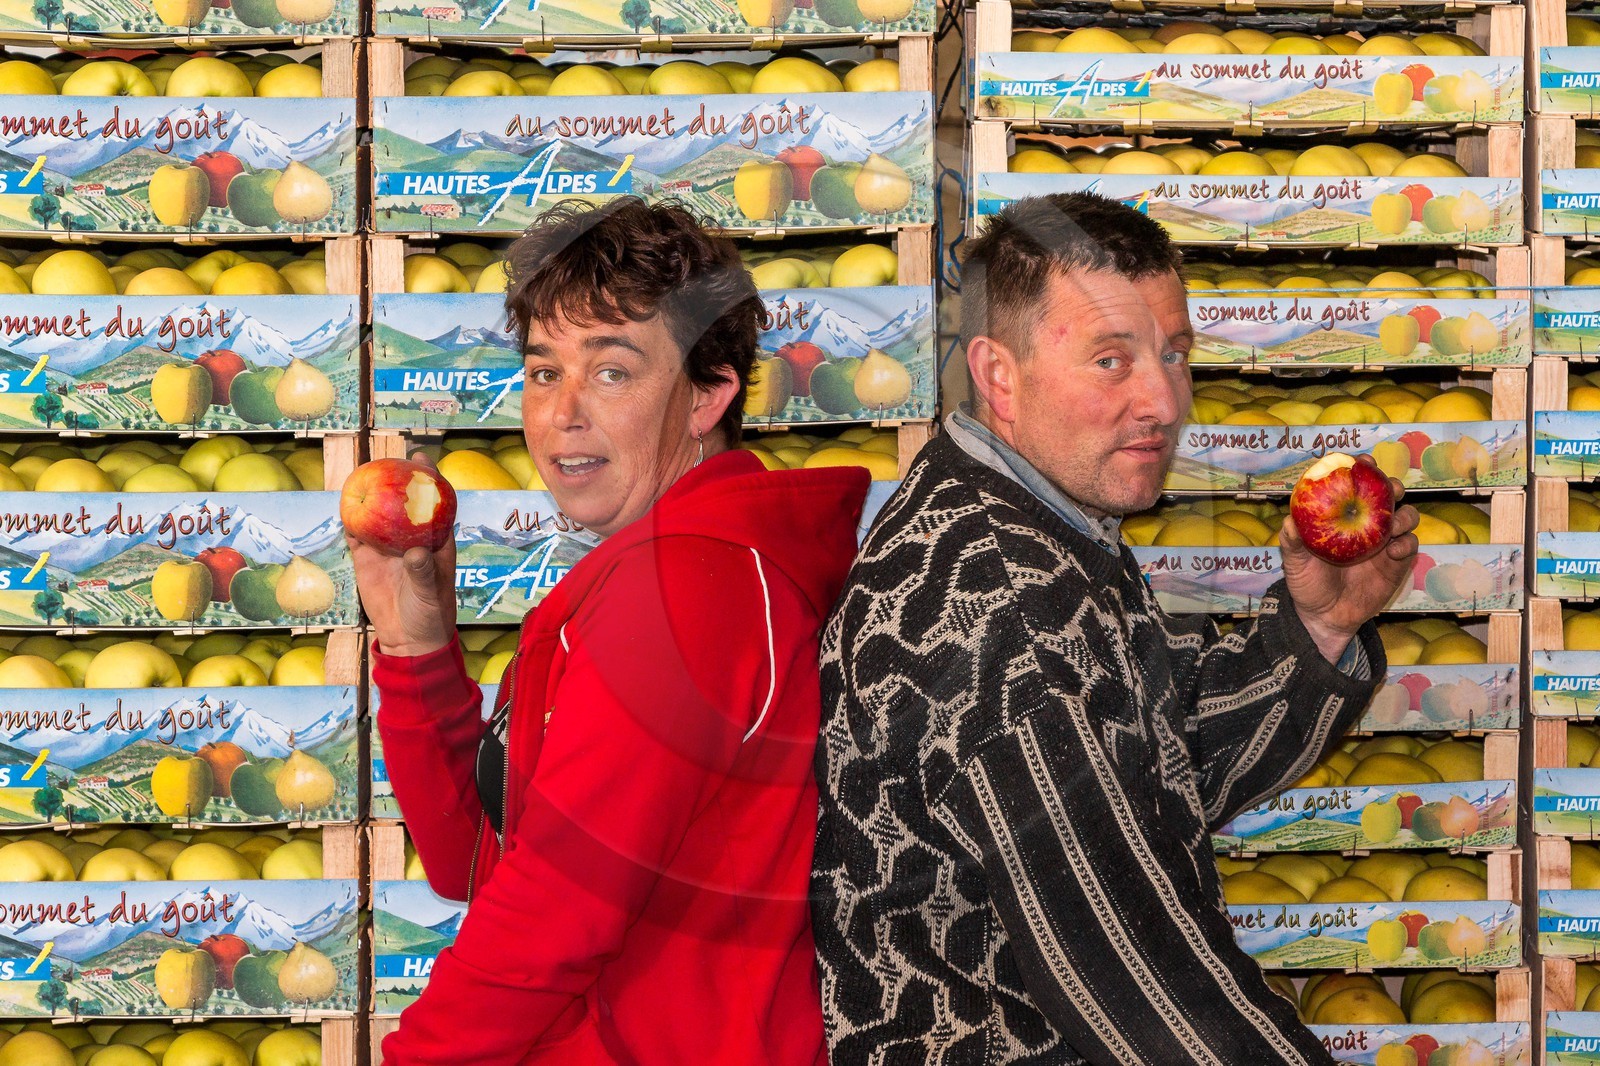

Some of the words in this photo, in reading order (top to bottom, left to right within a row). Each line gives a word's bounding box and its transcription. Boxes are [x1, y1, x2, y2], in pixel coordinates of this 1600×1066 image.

[1000, 82, 1057, 97] HAUTES
[1049, 58, 1126, 118] ALPES
[1156, 61, 1182, 79] au
[1190, 59, 1271, 79] sommet
[1279, 56, 1306, 79] du
[1314, 58, 1363, 89] goût
[1561, 74, 1600, 88] HAUT
[0, 109, 88, 138] mmet
[102, 105, 142, 139] du
[154, 108, 229, 154] goût
[505, 113, 542, 137] au
[556, 107, 675, 137] sommet
[688, 103, 727, 137] du
[739, 105, 810, 150] goût
[402, 174, 490, 195] HAUTES
[478, 139, 597, 225] ALPES
[1154, 181, 1181, 198] au
[1188, 179, 1270, 199] sommet
[1277, 176, 1304, 199] du
[1313, 178, 1362, 210] goût
[1557, 196, 1600, 209] HAUT
[0, 308, 91, 338] mmet
[104, 305, 145, 338] du
[157, 307, 231, 353] goût
[760, 301, 809, 331] oût
[1196, 300, 1278, 321] sommet
[1285, 297, 1313, 321] du
[1320, 299, 1370, 331] goût
[1550, 314, 1600, 328] HAUTE
[403, 371, 490, 391] HAUTES
[1188, 428, 1269, 449] sommet
[1277, 426, 1304, 449] du
[1312, 427, 1361, 459] goût
[1550, 441, 1600, 455] HAUTE
[0, 506, 91, 534] mmet
[104, 502, 144, 534] du
[157, 505, 231, 549] goût
[503, 509, 541, 531] au
[1156, 553, 1182, 570] au
[1191, 550, 1273, 571] sommet
[455, 568, 488, 587] TES
[0, 702, 91, 731] mmet
[104, 698, 144, 731] du
[157, 700, 231, 745] goût
[1268, 791, 1295, 811] du
[1302, 789, 1352, 820] goût
[1556, 798, 1600, 811] HAUT
[0, 895, 95, 924] mmet
[108, 891, 149, 924] du
[161, 892, 234, 938] goût
[1229, 908, 1266, 928] met
[1274, 905, 1301, 928] du
[1308, 906, 1358, 938] goût
[1557, 919, 1600, 932] HAUT
[1564, 1038, 1600, 1052] HAU
